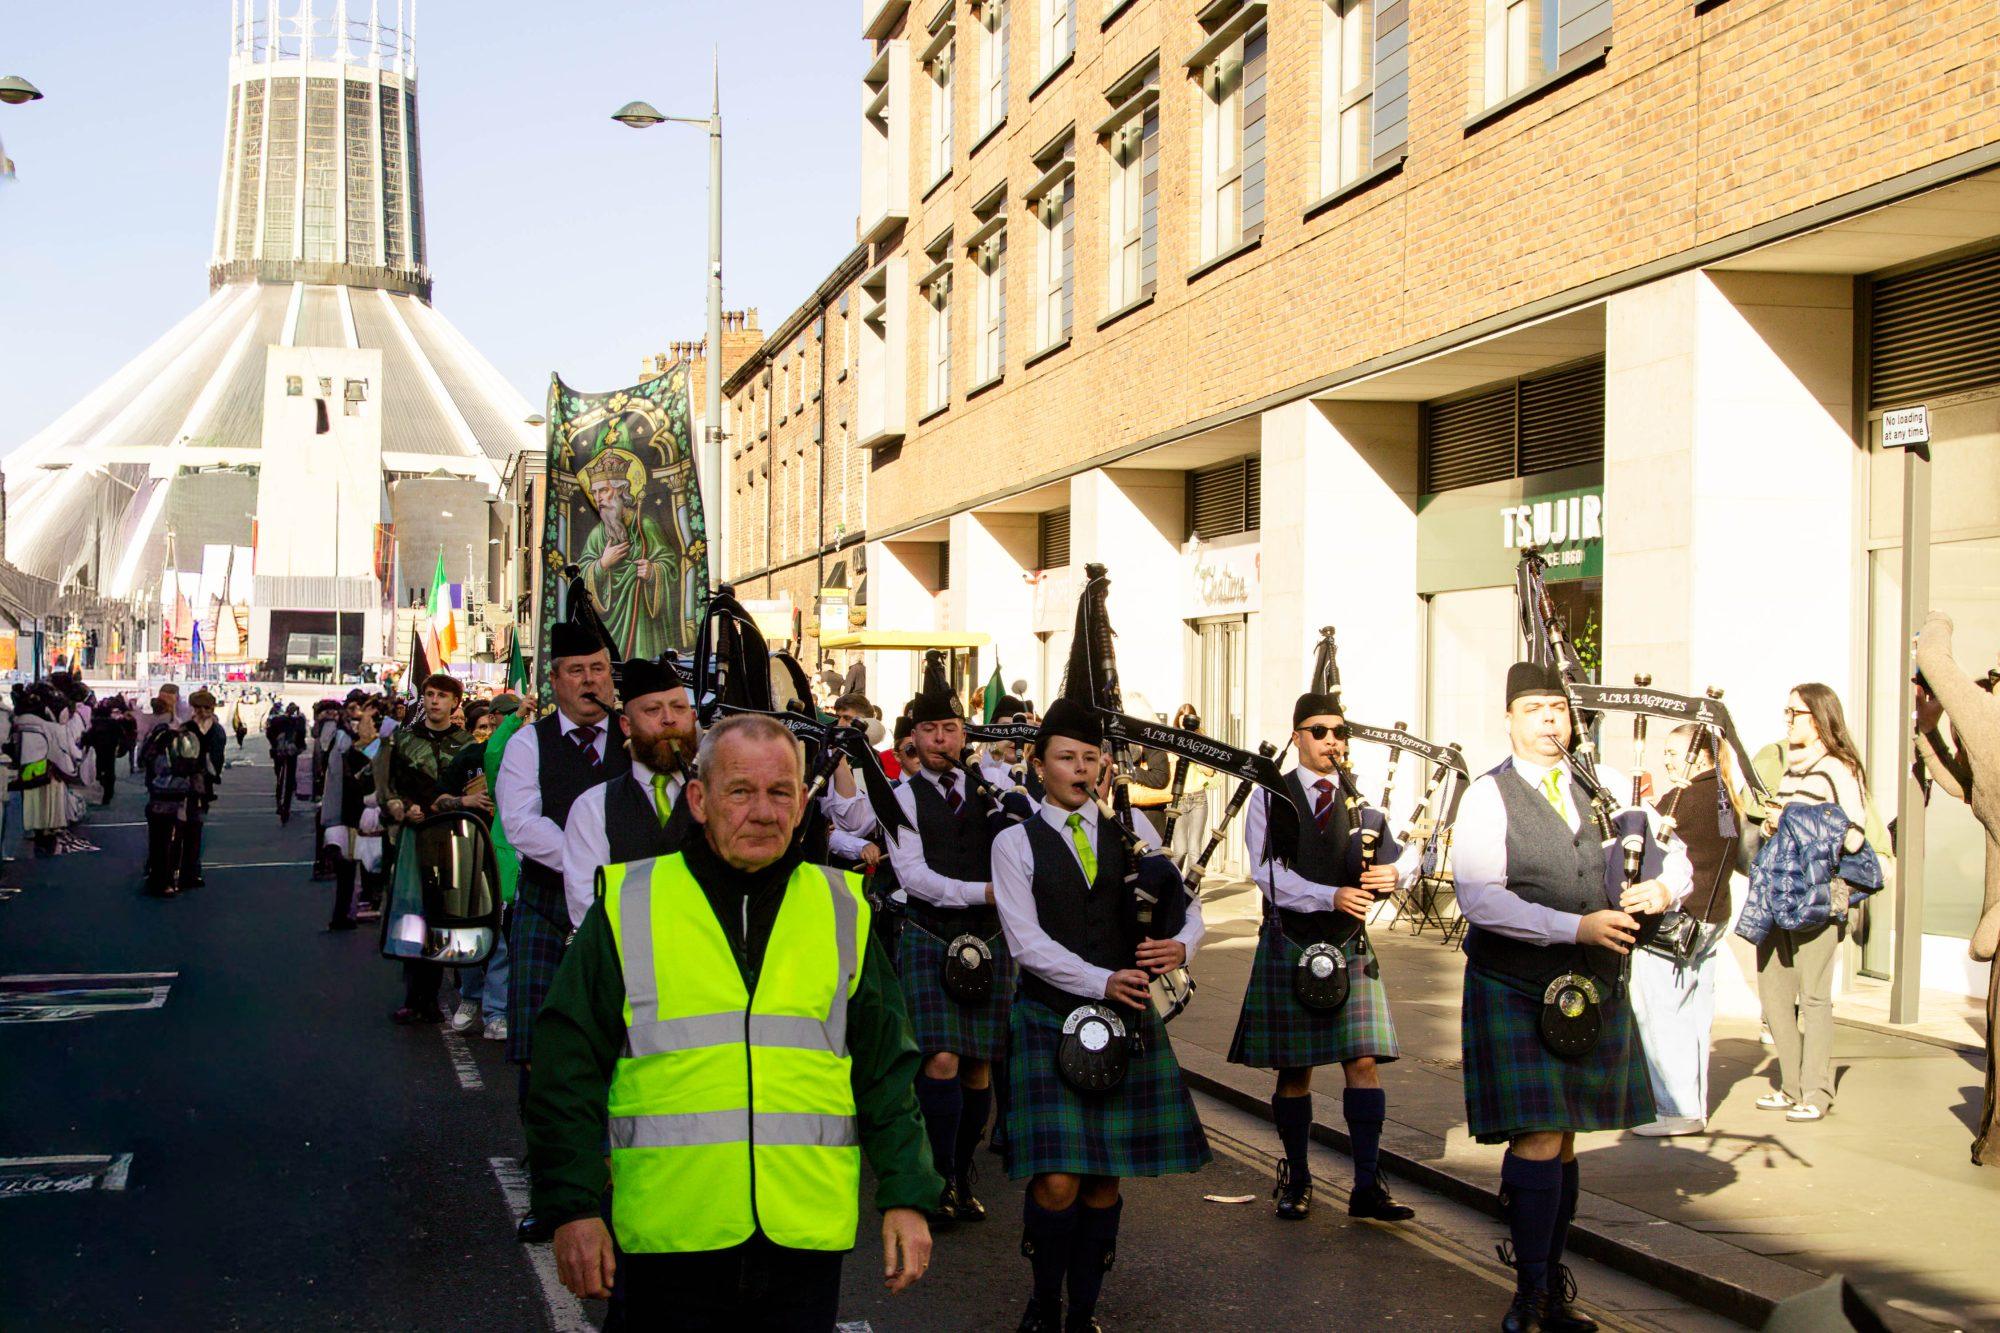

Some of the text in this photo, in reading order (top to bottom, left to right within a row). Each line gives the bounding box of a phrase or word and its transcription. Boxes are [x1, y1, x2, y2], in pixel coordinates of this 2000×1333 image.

[1886, 412, 1923, 425] No loading
[1885, 427, 1924, 440] at any time
[1500, 495, 1604, 550] TSUJIR
[1597, 692, 1631, 705] ALBA
[1631, 693, 1687, 712] BAGPIPES
[983, 726, 1038, 736] ALBA BAGPI
[1361, 728, 1432, 754] ALBA BAGPIPES
[1140, 727, 1175, 743] ALBA
[1176, 735, 1232, 762] BAGPIPES
